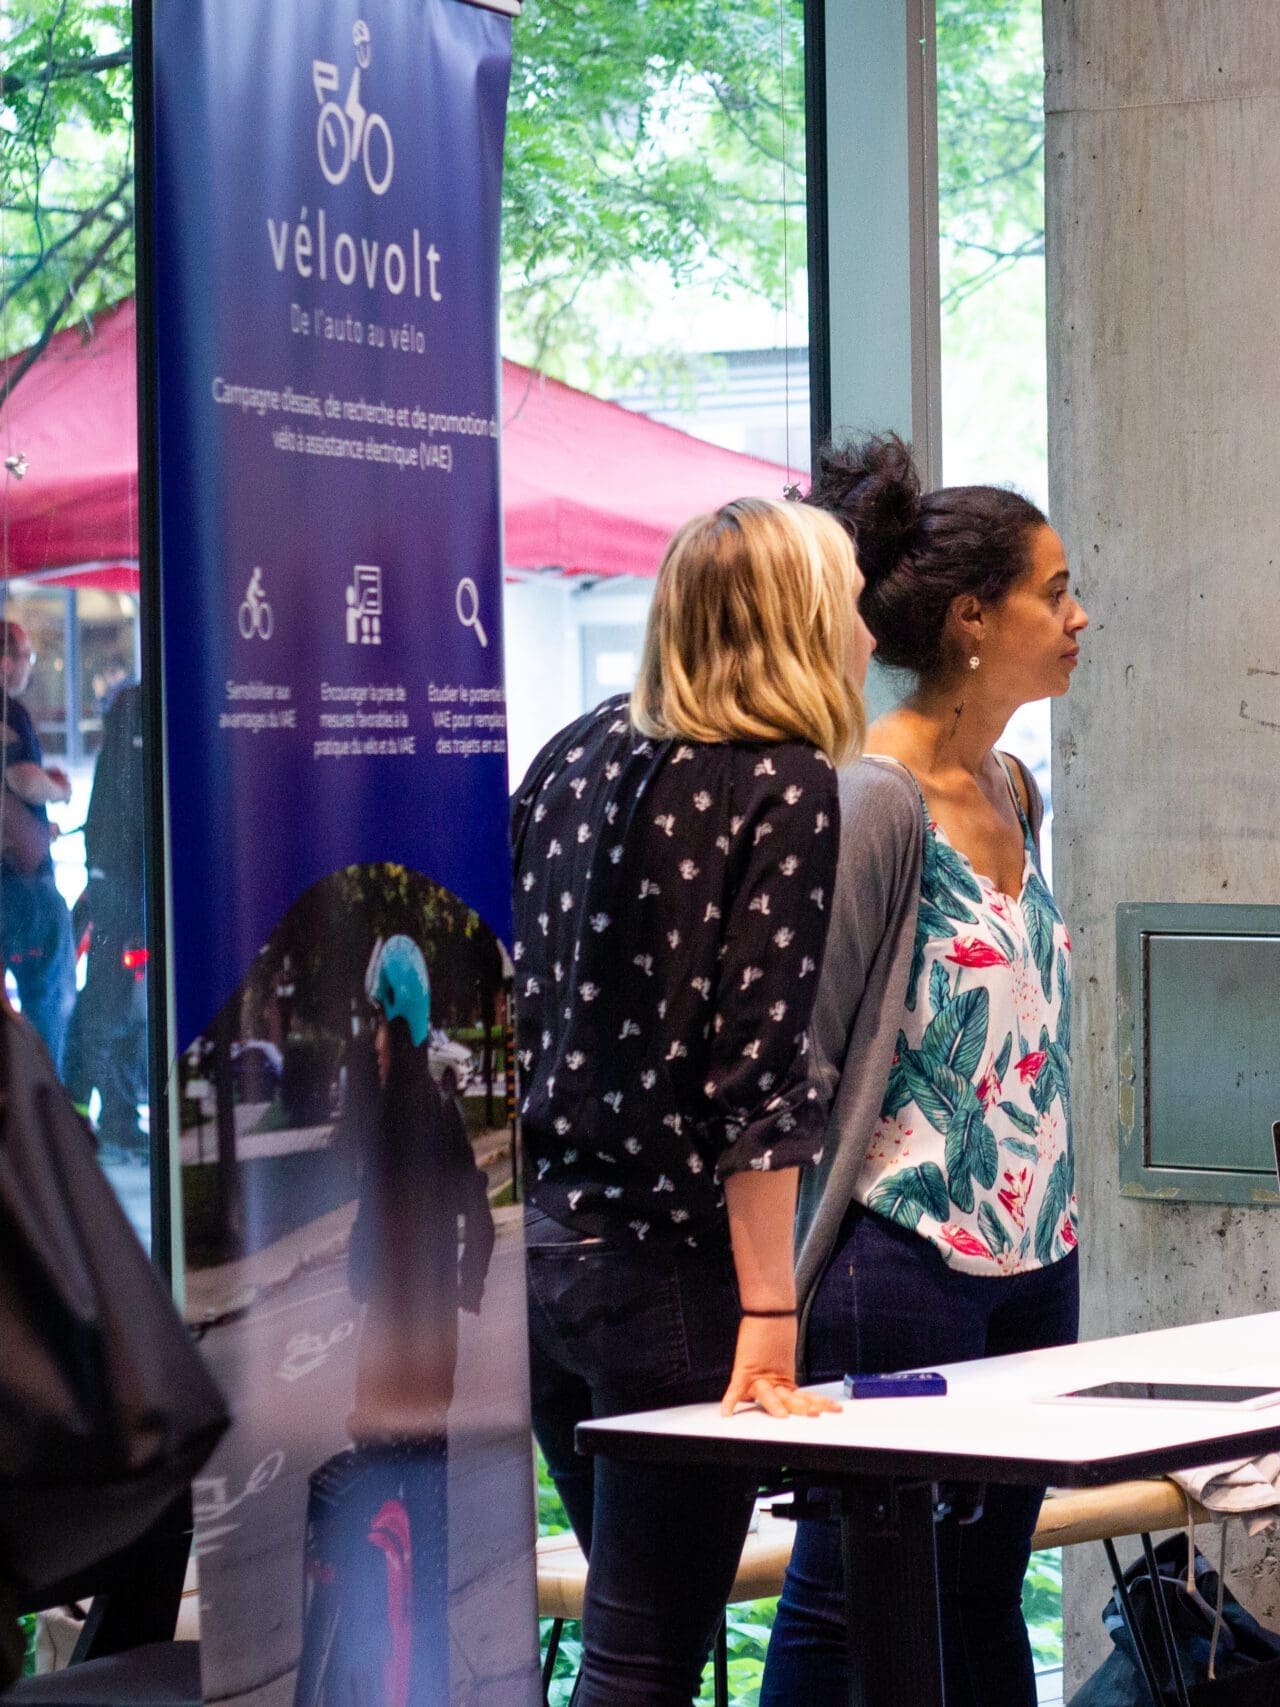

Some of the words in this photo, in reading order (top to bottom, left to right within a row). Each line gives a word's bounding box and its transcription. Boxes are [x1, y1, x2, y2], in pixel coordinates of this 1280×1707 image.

[267, 205, 442, 301] vélovolt
[291, 303, 310, 335] De
[314, 308, 363, 343] l'auto
[368, 323, 385, 348] au
[390, 323, 426, 354] vélo
[212, 377, 280, 416] Campagne
[324, 393, 341, 419] de
[342, 399, 396, 427] recherche
[396, 407, 410, 428] et
[411, 404, 427, 430] de
[427, 411, 489, 437] promotion
[305, 430, 365, 460] assistance
[365, 436, 419, 471] électrique
[420, 441, 453, 473] (VAE)
[428, 681, 459, 702] Étudier
[452, 714, 474, 733] pour
[436, 736, 452, 755] des
[453, 737, 480, 759] trajets
